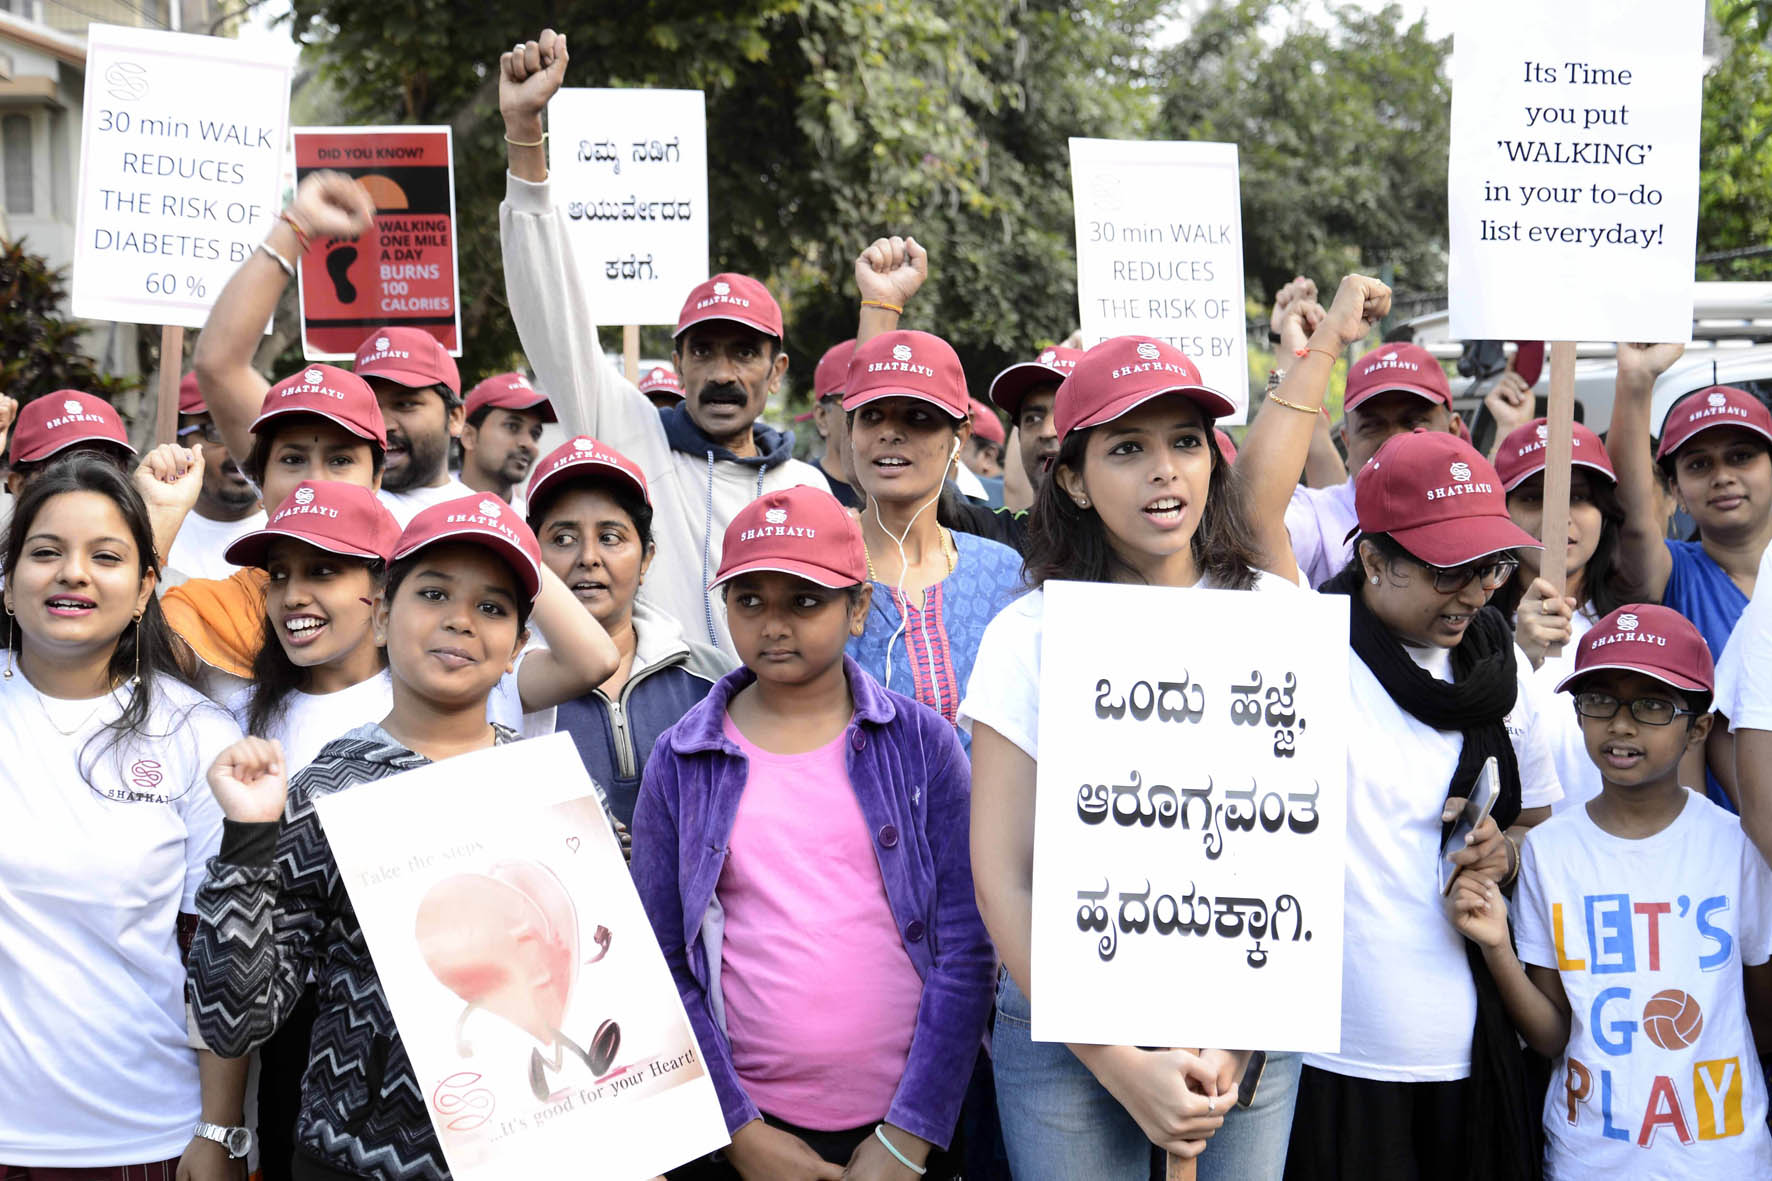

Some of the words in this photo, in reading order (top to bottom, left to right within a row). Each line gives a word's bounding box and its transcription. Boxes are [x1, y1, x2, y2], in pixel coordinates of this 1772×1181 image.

[1523, 61, 1557, 84] Its
[1564, 62, 1632, 85] Time
[1525, 106, 1576, 127] you
[1583, 104, 1629, 129] put
[98, 109, 130, 133] 30
[140, 115, 189, 139] min
[199, 119, 273, 149] WALK
[317, 148, 341, 160] DID
[344, 148, 373, 160] YOU
[376, 147, 424, 160] KNOW?
[578, 139, 621, 175] ನಿಮ್ಮ
[123, 152, 244, 184] REDUCES
[1484, 180, 1511, 202] in
[1519, 185, 1583, 206] your
[1591, 183, 1663, 206] to-do
[100, 189, 151, 214] THE
[162, 195, 218, 221] RISK
[226, 202, 262, 225] OF
[378, 220, 447, 233] WALKING
[1090, 221, 1115, 243] 30
[1123, 221, 1163, 243] min
[1170, 223, 1231, 245] WALK
[1481, 219, 1522, 242] list
[1528, 222, 1664, 249] everyday!
[94, 228, 220, 260] DIABETES
[380, 234, 409, 247] ONE
[415, 234, 448, 247] MILE
[380, 250, 391, 261] A
[394, 249, 423, 261] DAY
[380, 264, 440, 280] BURNS
[1113, 260, 1215, 282] REDUCES
[146, 272, 177, 295] 60
[186, 275, 206, 298] %
[381, 281, 409, 296] 100
[381, 297, 450, 312] CALORIES
[697, 295, 750, 310] SHATHAYU
[1097, 298, 1142, 320] THE
[1148, 298, 1198, 320] RISK
[1204, 298, 1231, 320] OF
[1211, 336, 1235, 357] BY
[868, 361, 934, 378] SHATHAYU
[1112, 361, 1187, 379] SHATHAYU
[281, 384, 344, 400] SHATHAYU
[553, 450, 618, 469] SHATHAYU
[1427, 483, 1492, 500] SHATHAYU
[447, 514, 521, 546] SHATHAYU
[740, 525, 816, 542] SHATHAYU
[1592, 632, 1667, 649] SHATHAYU
[1095, 667, 1205, 725] ಒಂದು
[357, 864, 402, 889] Take
[408, 855, 435, 873] the
[1552, 893, 1734, 974] LET'S
[533, 1095, 576, 1129] good
[578, 1083, 605, 1106] for
[610, 1070, 645, 1098] your
[648, 1049, 696, 1079] Heart!
[1565, 1056, 1744, 1149] PLAY
